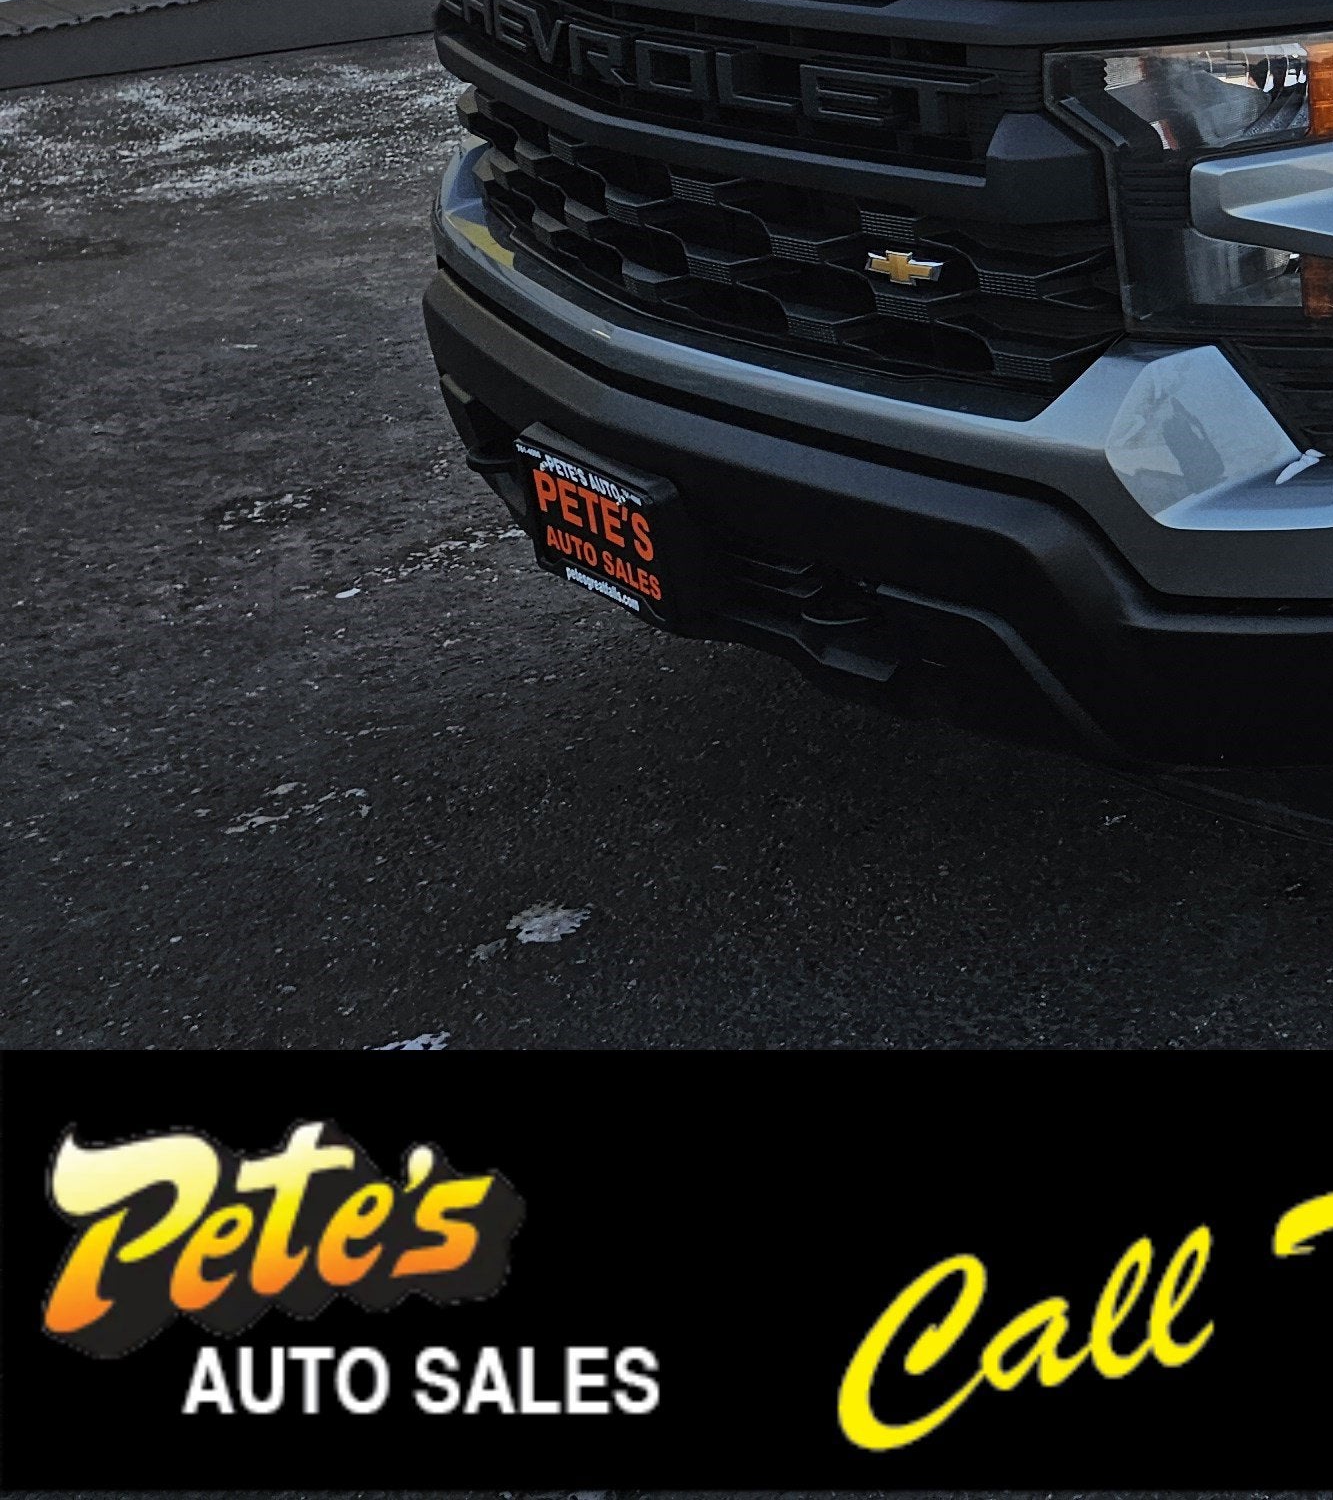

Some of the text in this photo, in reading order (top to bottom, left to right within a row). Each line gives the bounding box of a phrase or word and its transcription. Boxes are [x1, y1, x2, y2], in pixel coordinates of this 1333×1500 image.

[533, 468, 654, 562] PETE'S
[544, 454, 589, 487] PETE'S
[588, 473, 620, 501] AUTO
[546, 525, 662, 601] AUTO SALES
